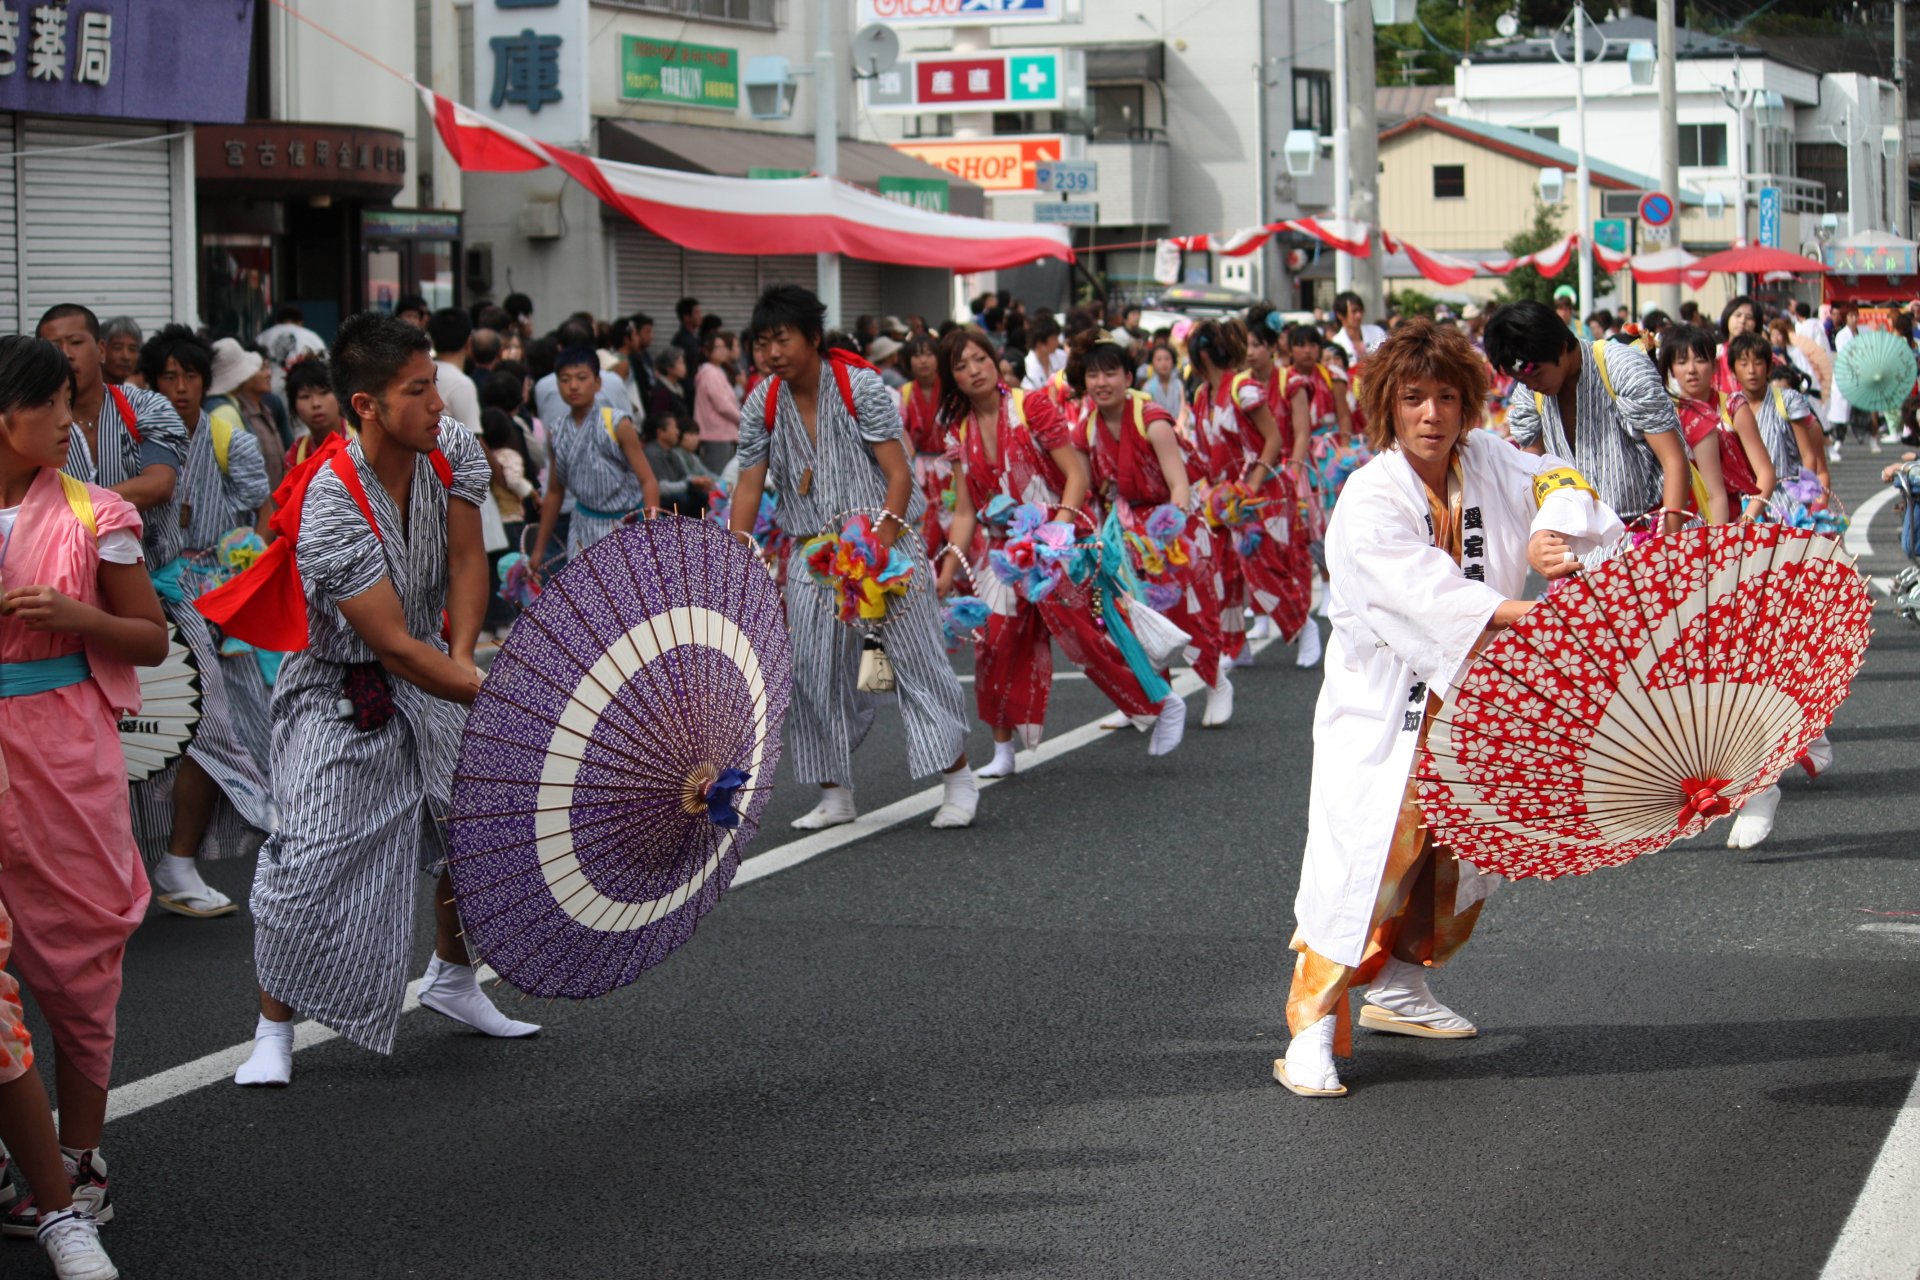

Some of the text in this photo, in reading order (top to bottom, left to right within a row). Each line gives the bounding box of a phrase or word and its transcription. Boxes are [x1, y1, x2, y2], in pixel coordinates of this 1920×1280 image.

[489, 0, 562, 114] 庫
[931, 68, 992, 95] 産直
[1055, 172, 1089, 189] 239
[1401, 671, 1427, 732] 木節
